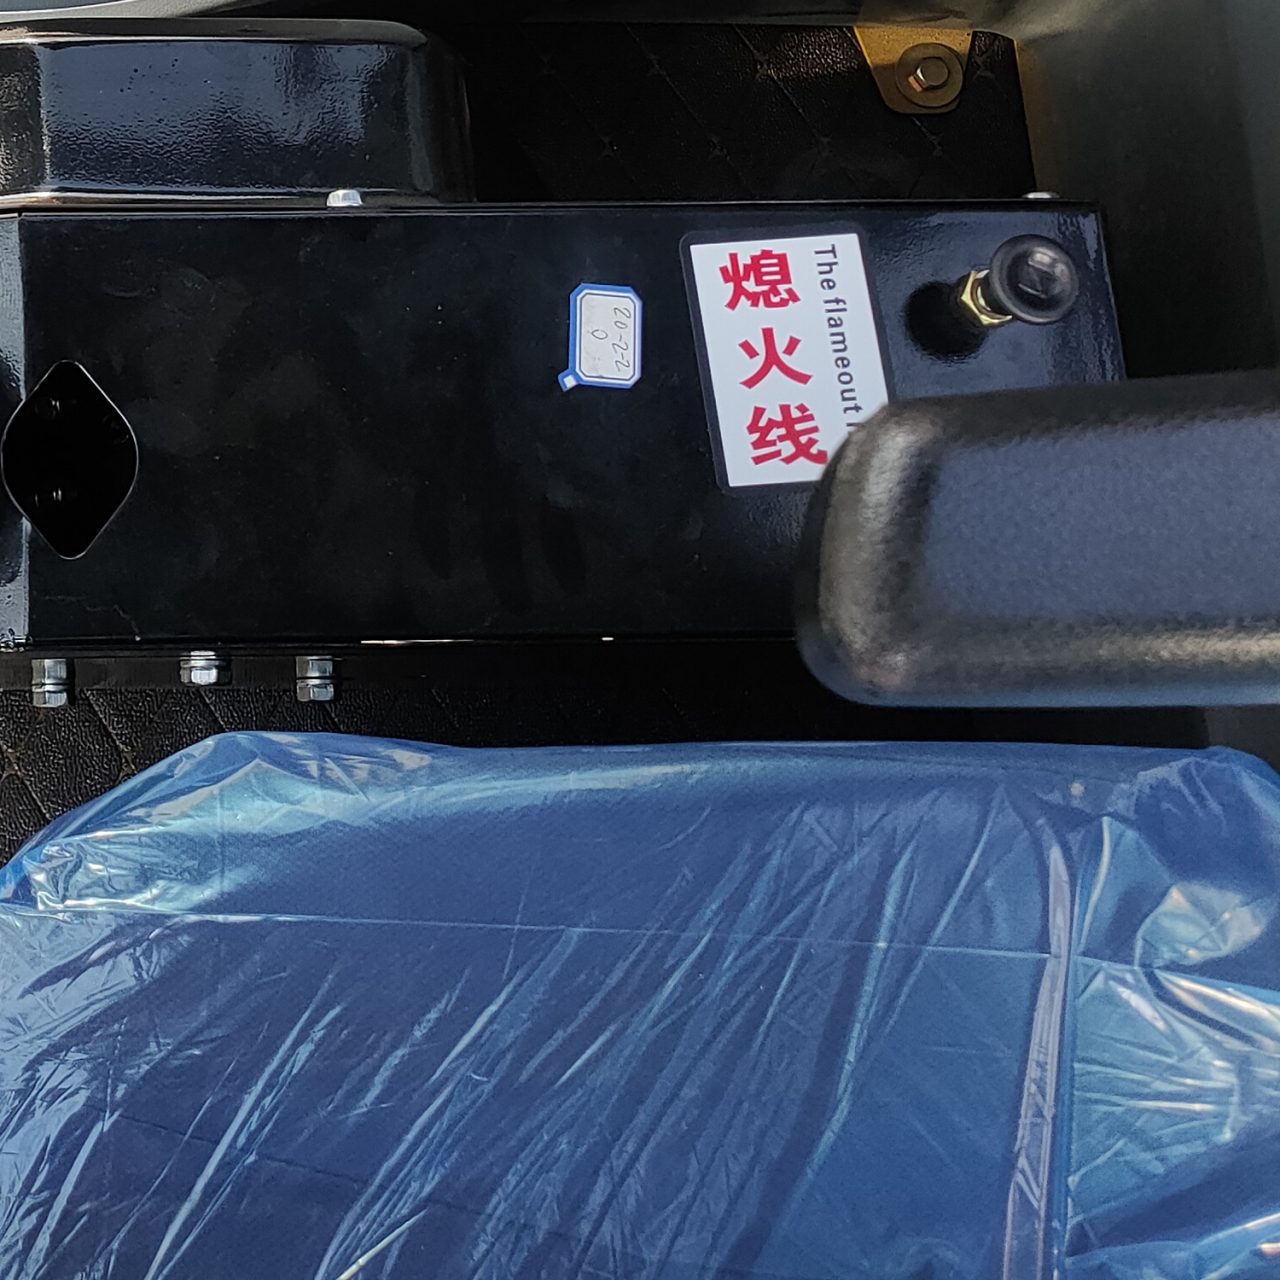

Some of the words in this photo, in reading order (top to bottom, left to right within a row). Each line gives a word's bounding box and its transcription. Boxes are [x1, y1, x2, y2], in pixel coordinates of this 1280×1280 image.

[814, 244, 839, 290] The
[719, 249, 829, 465] 熄火线
[823, 296, 863, 414] flameout
